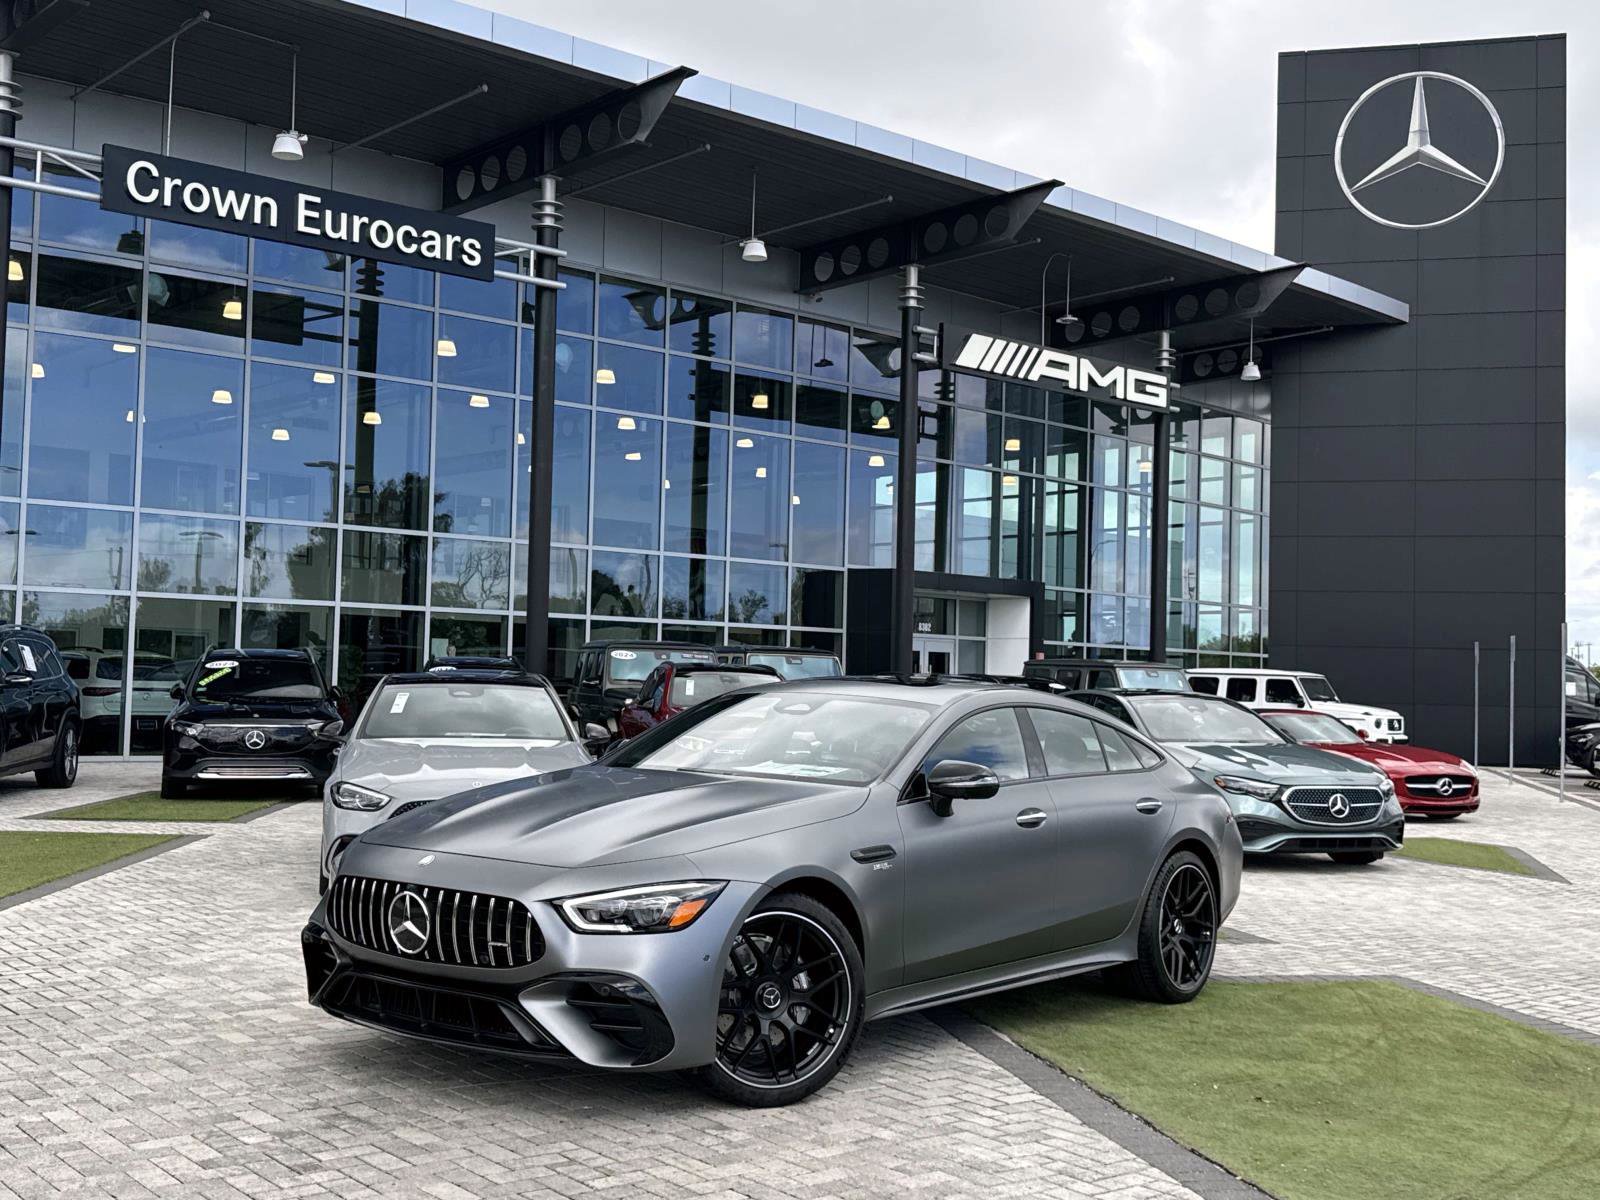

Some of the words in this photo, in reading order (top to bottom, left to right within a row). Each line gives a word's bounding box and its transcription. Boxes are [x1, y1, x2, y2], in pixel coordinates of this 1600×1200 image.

[125, 160, 279, 228] Crown
[296, 192, 482, 268] Eurocars
[1027, 348, 1168, 408] AMG
